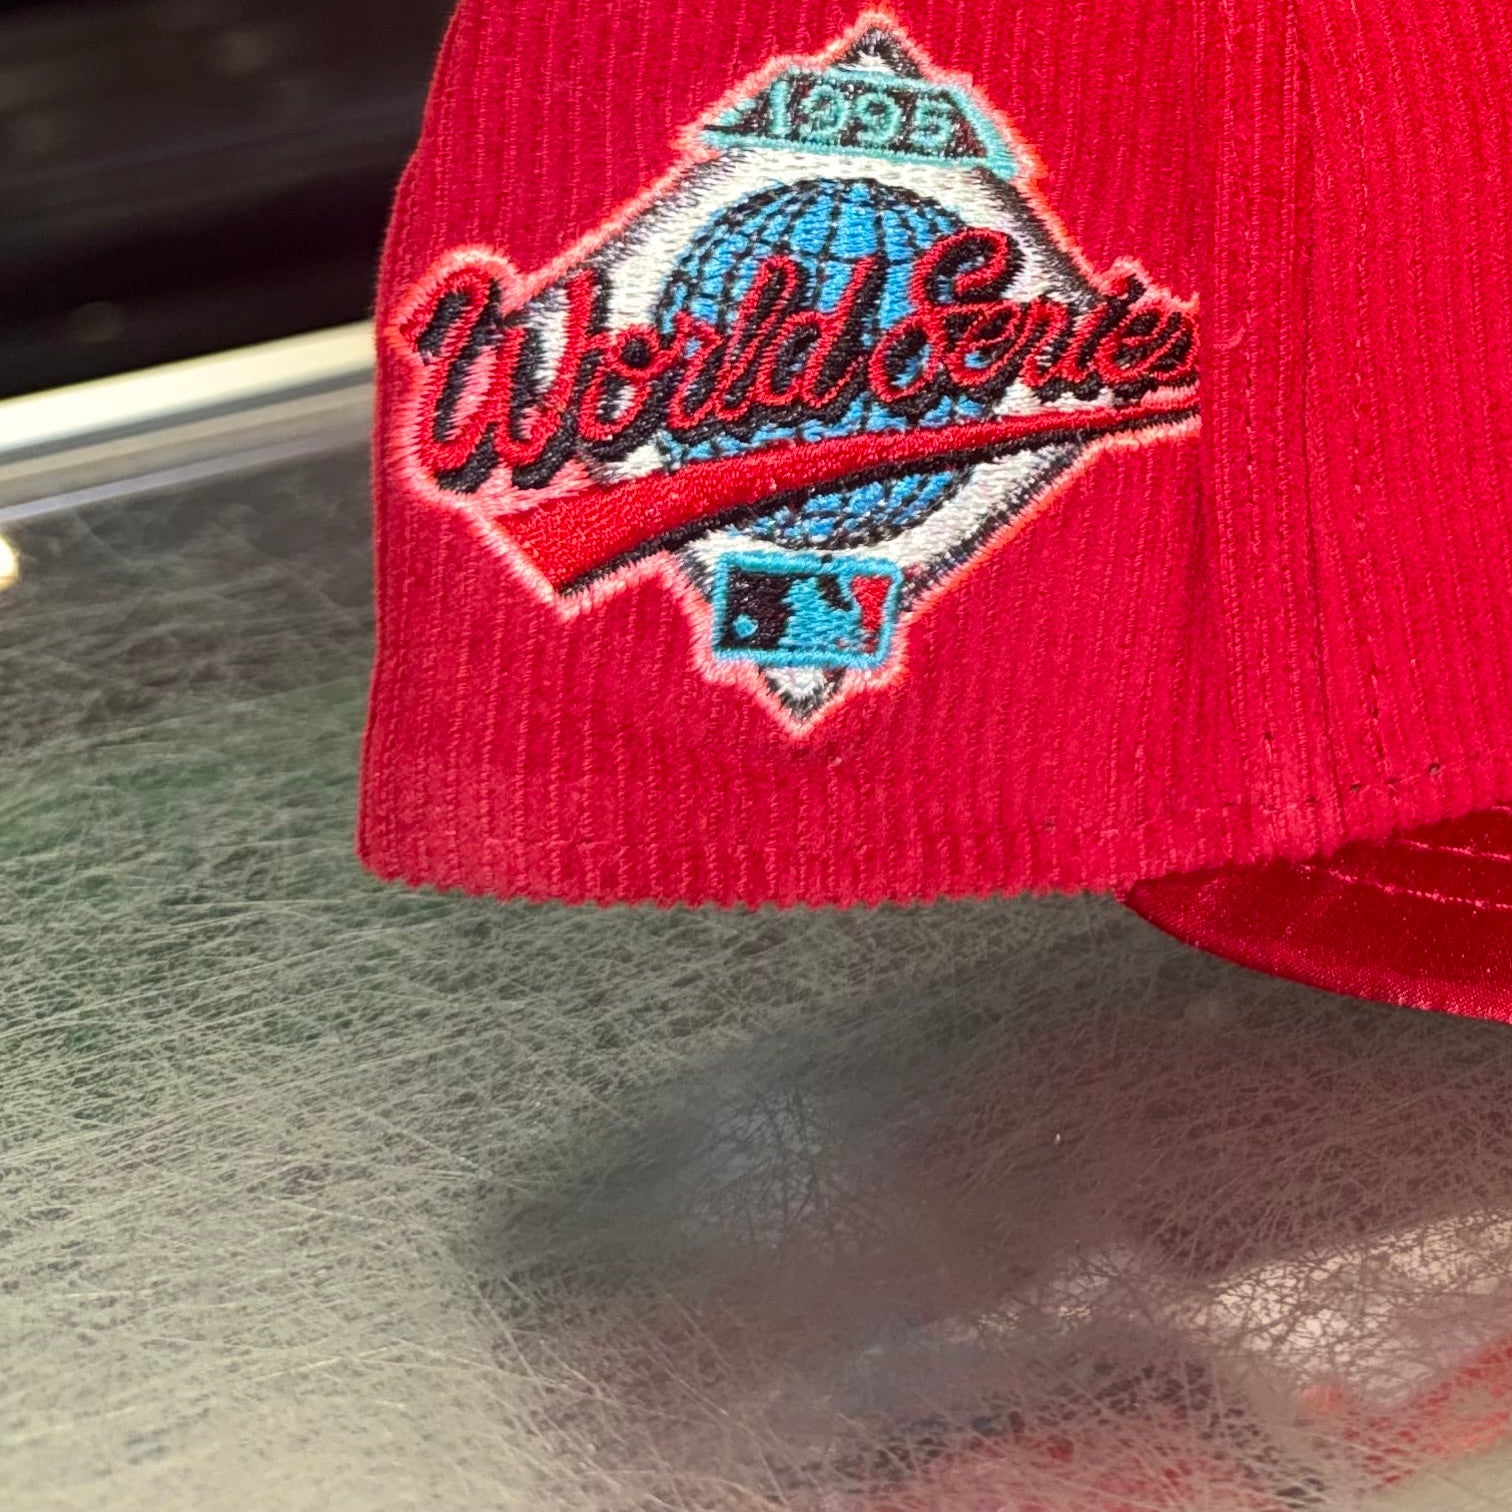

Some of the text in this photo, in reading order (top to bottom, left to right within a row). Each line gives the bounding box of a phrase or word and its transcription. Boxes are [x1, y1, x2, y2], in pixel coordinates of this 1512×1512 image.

[770, 78, 954, 150] 1995
[400, 226, 1199, 488] World Series
